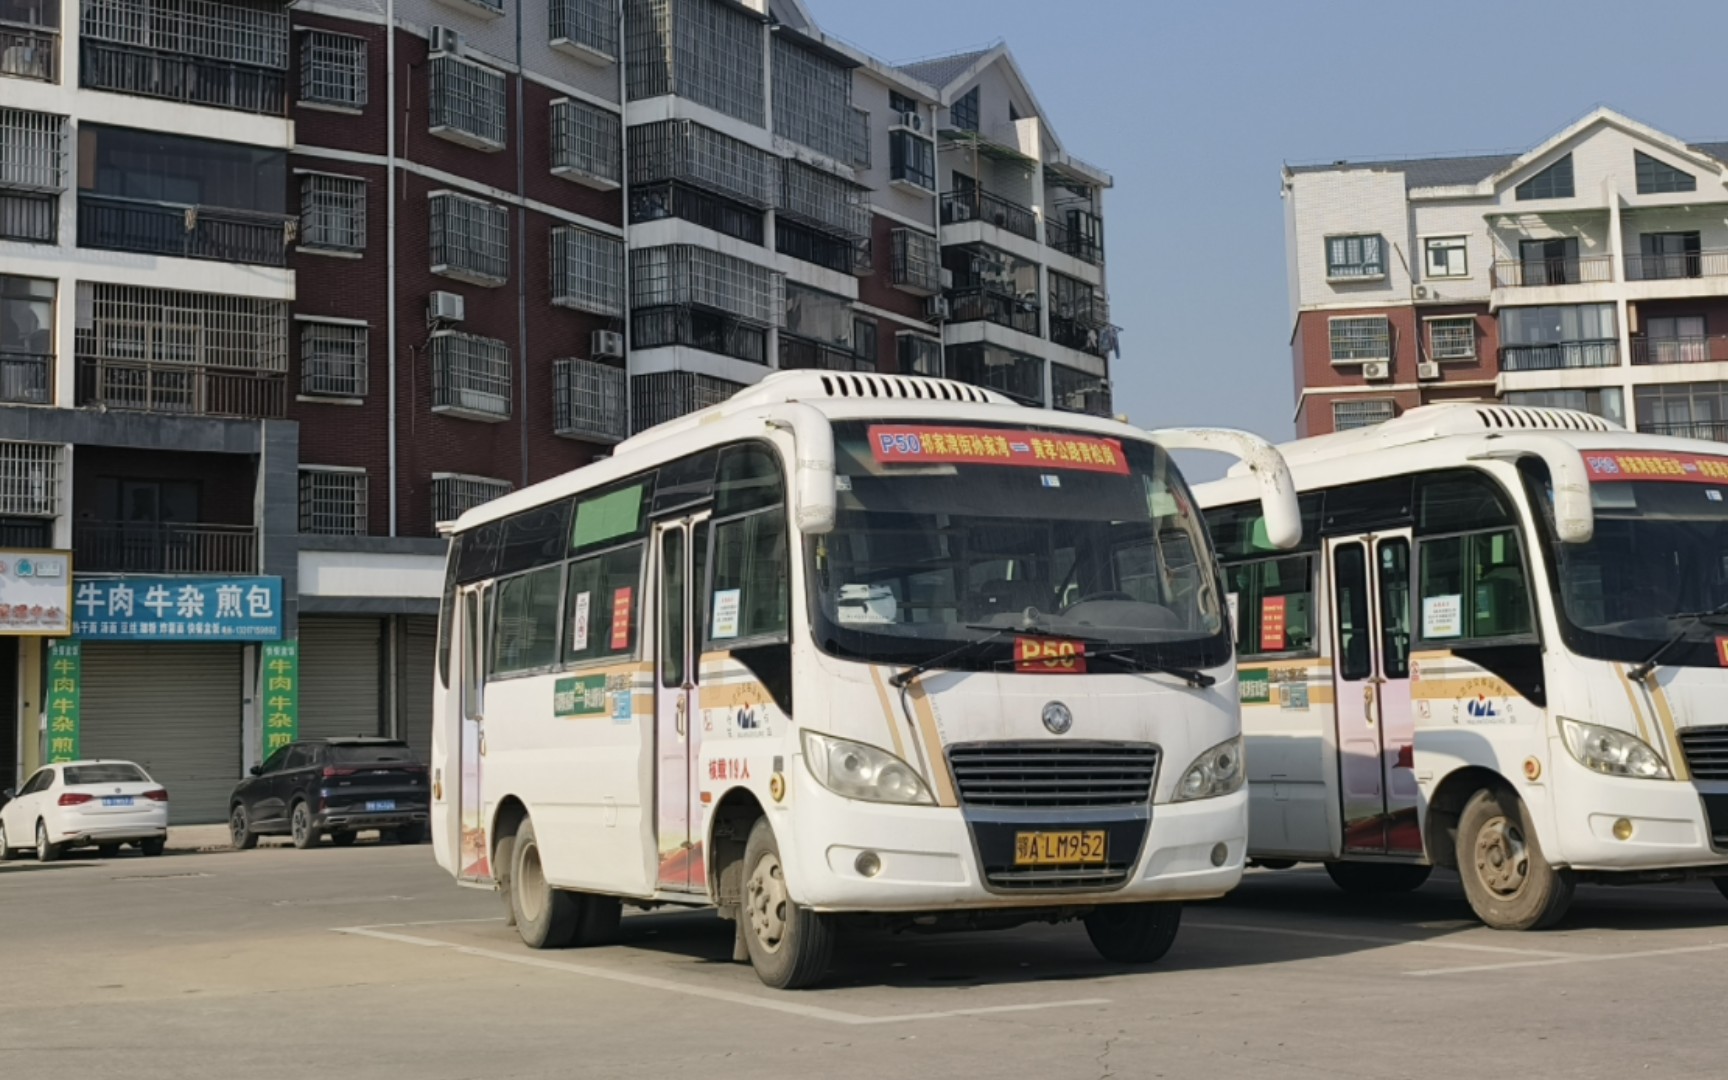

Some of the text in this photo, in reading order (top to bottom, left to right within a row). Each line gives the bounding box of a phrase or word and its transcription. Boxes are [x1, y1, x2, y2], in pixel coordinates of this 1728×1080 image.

[877, 433, 921, 454] P50
[76, 582, 134, 618] 牛肉
[143, 583, 205, 619] 牛杂
[215, 584, 273, 618] 煎包
[1021, 639, 1075, 668] P50
